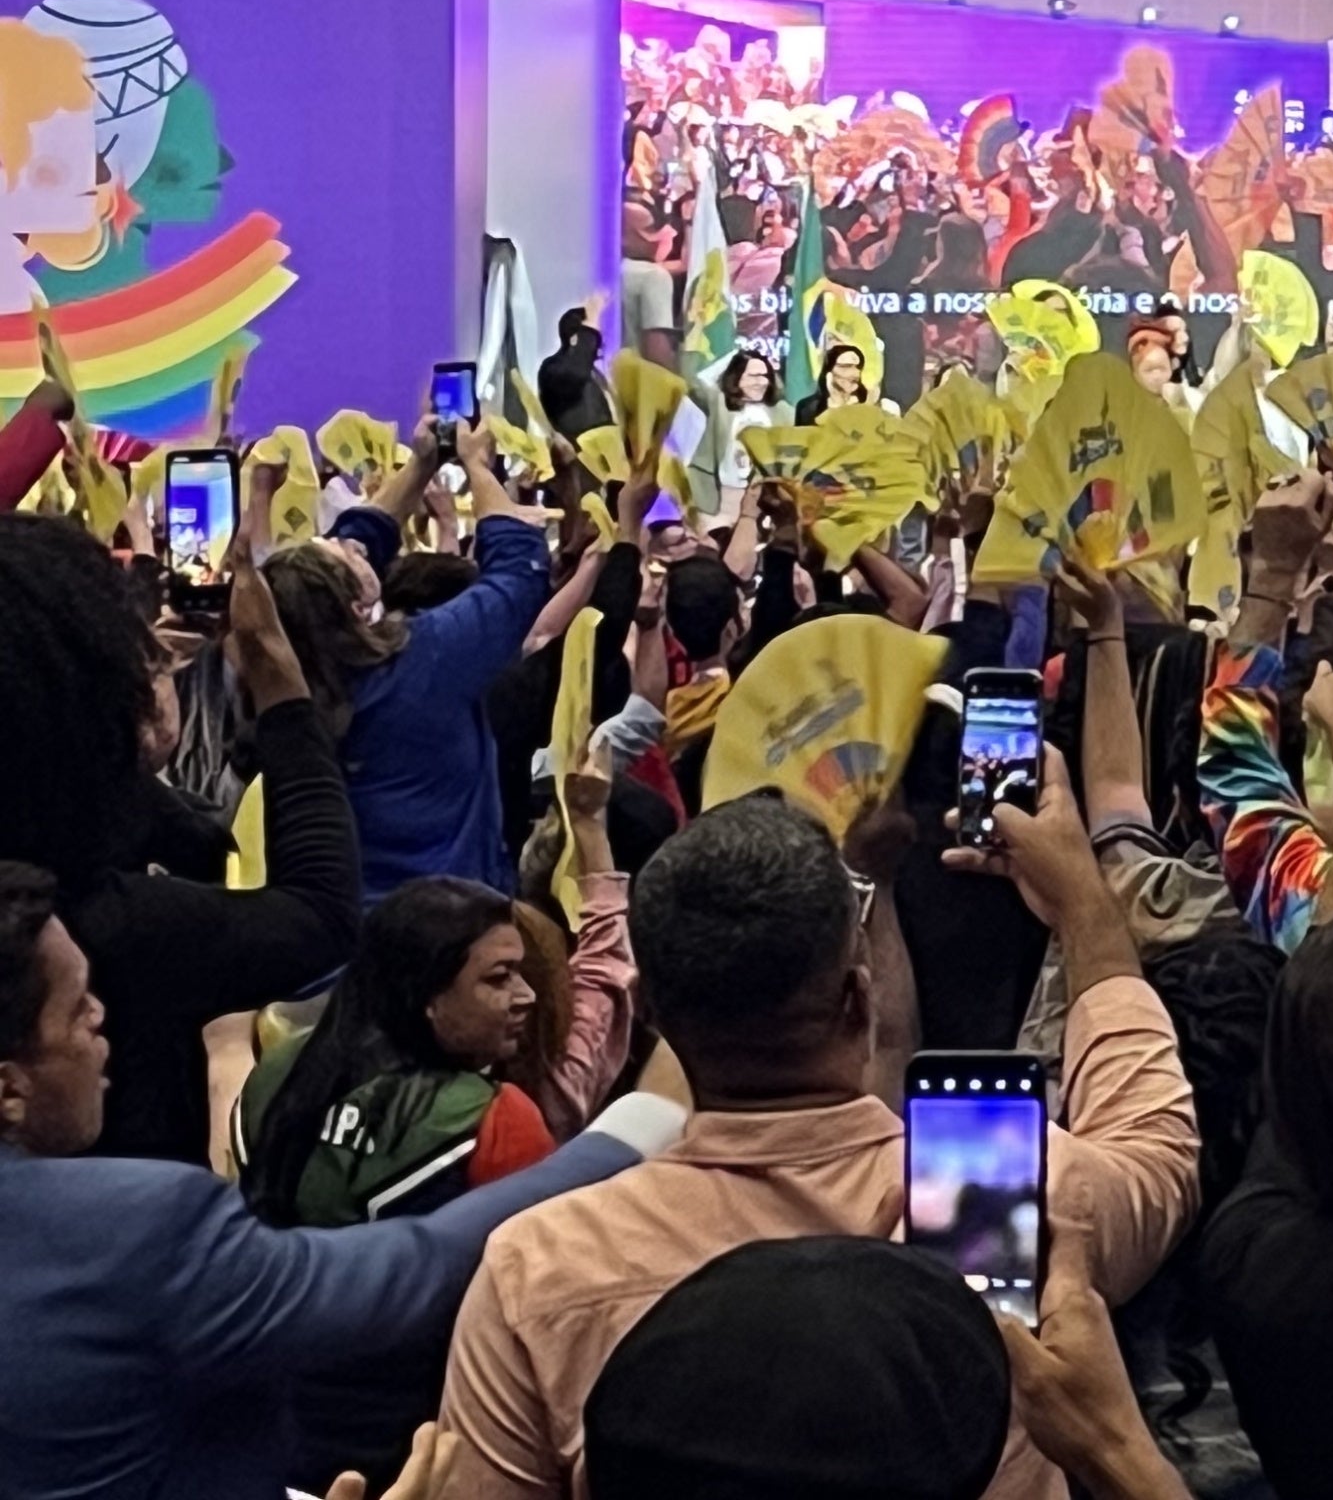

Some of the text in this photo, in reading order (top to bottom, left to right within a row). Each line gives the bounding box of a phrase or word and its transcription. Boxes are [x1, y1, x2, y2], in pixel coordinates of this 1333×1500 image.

[845, 285, 900, 313] viva
[907, 292, 926, 313] a
[1135, 292, 1154, 313] e
